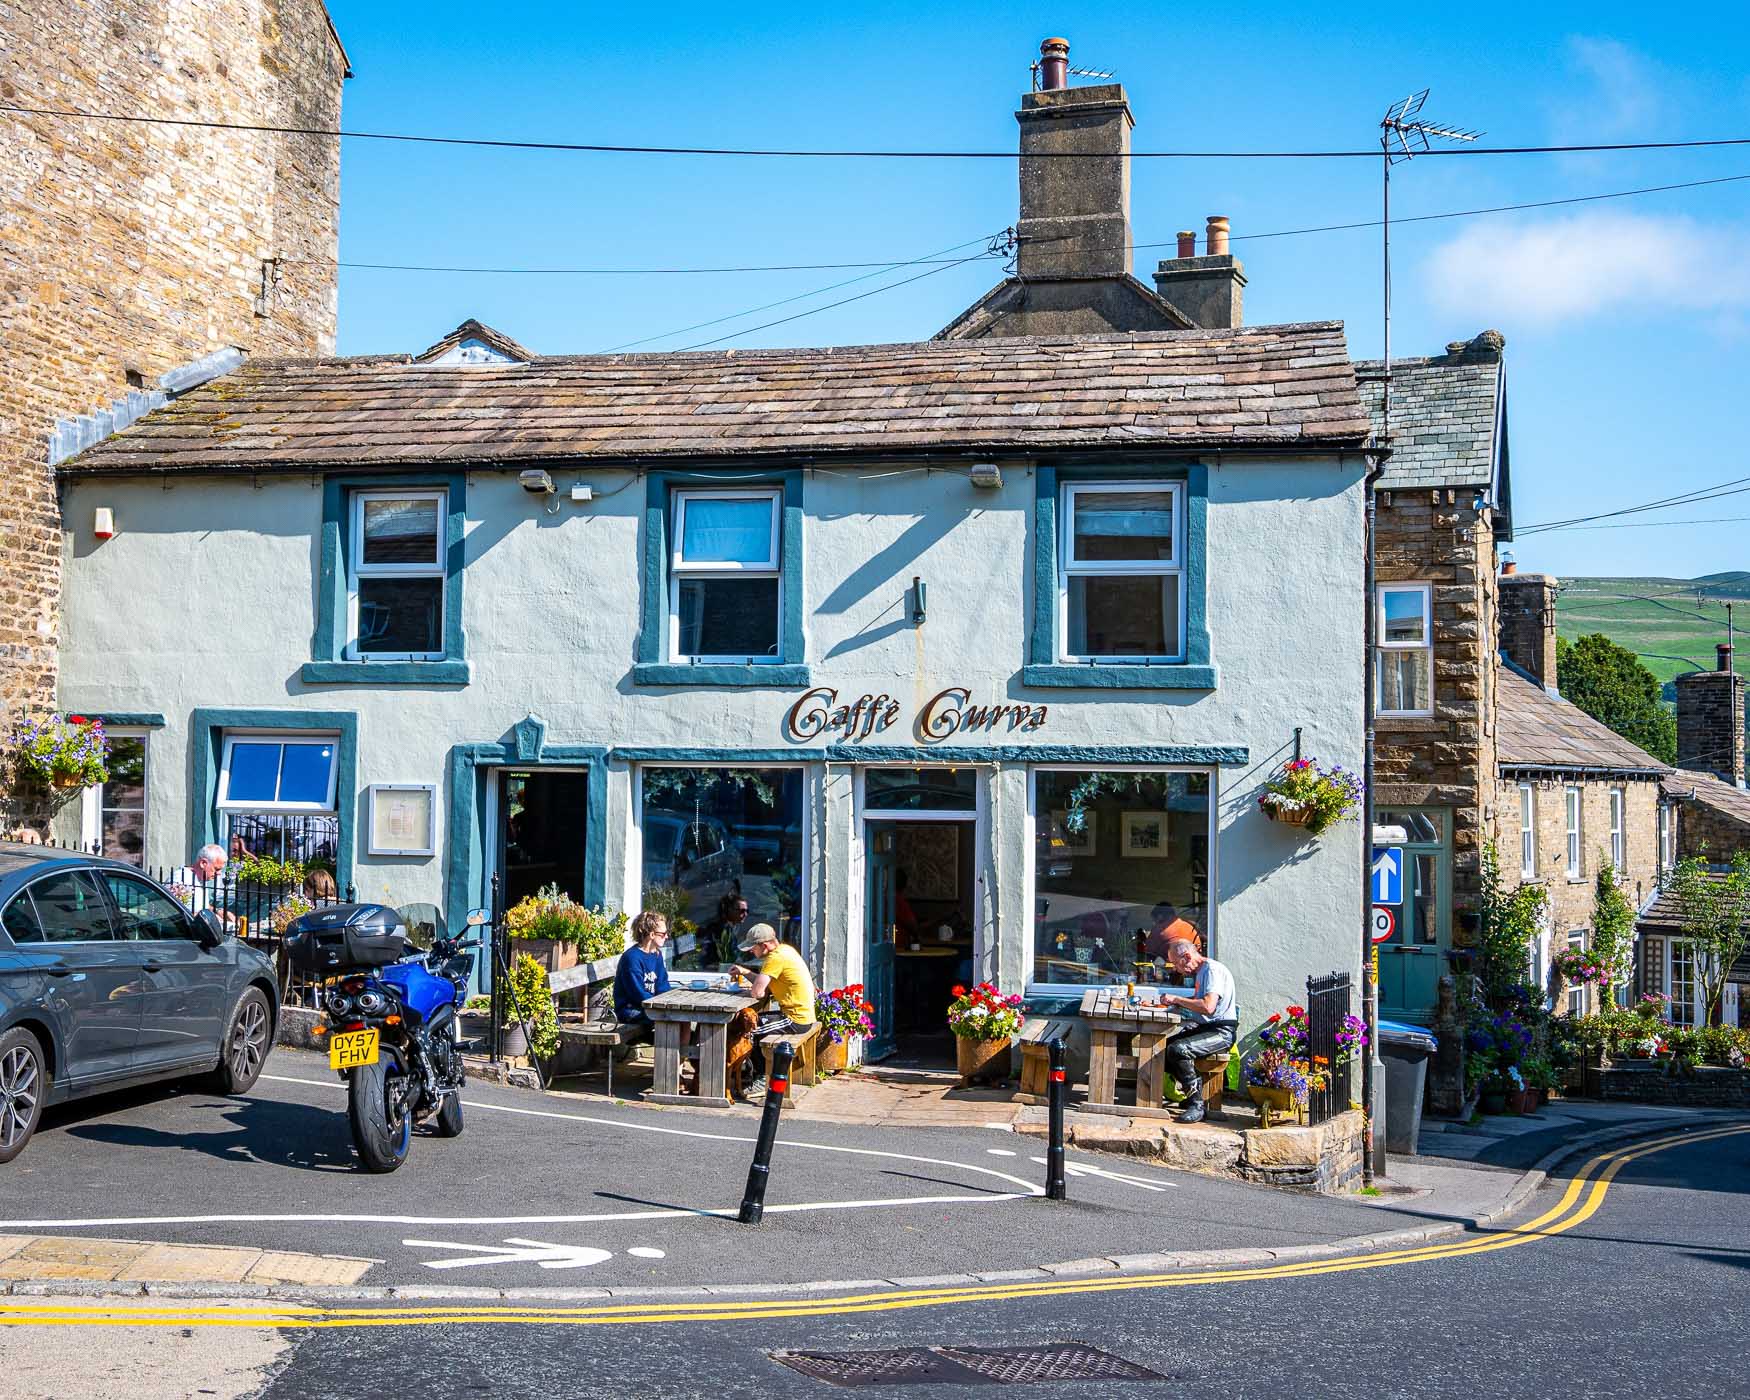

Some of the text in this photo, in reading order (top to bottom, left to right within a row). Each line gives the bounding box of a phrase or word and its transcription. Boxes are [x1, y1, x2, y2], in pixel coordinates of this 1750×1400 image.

[921, 687, 1048, 738] Curva
[1373, 915, 1388, 930] 0
[340, 1048, 369, 1064] FHV
